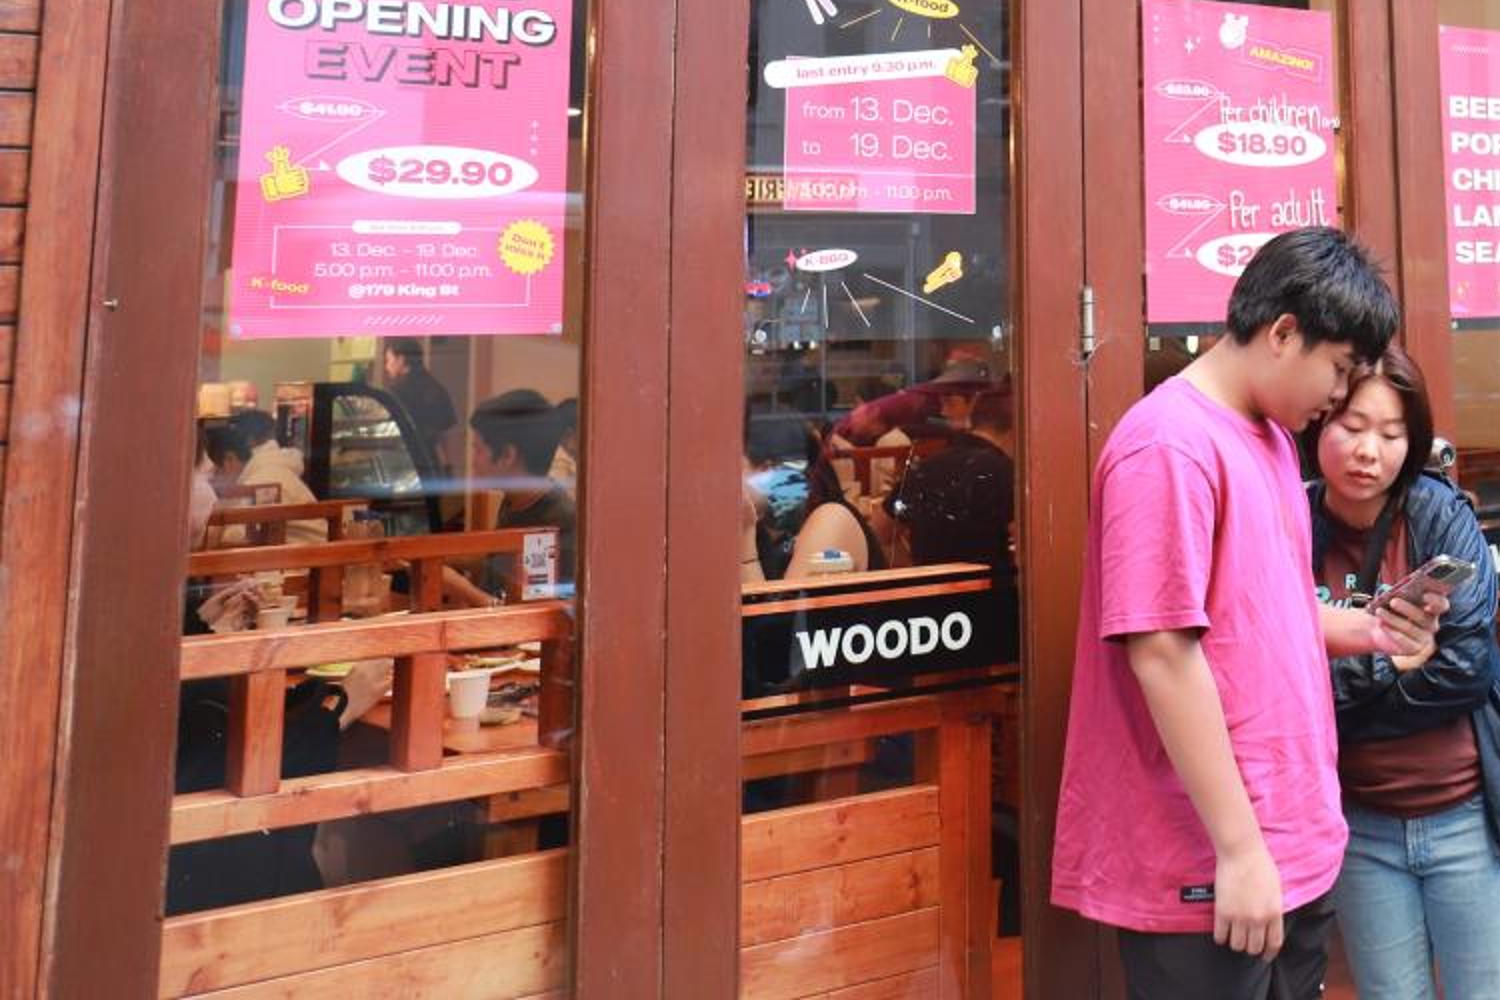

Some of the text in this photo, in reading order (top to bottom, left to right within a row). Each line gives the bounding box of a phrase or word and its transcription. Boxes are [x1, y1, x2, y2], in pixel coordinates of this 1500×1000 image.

[305, 39, 521, 90] EVENT
[802, 96, 953, 126] from 13. Dec.
[802, 133, 952, 161] to 19. Dec.
[1217, 131, 1307, 157] $18.90
[367, 156, 513, 189] $29.90
[1229, 186, 1329, 229] Per adult
[398, 283, 437, 298] King
[795, 611, 973, 670] WOODO
